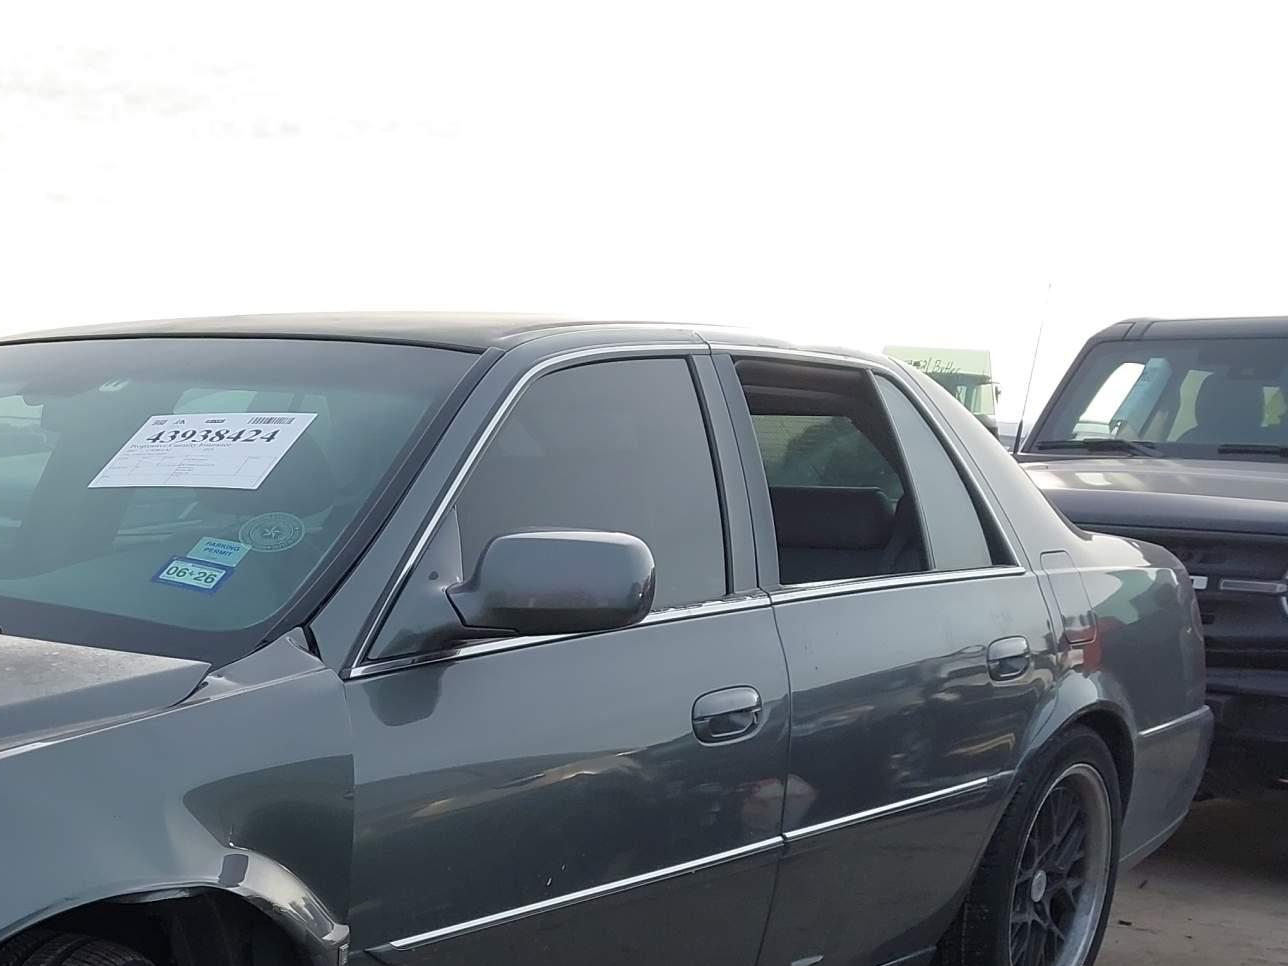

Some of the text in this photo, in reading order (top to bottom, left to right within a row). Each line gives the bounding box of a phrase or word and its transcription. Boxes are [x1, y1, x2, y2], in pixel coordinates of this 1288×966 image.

[145, 428, 281, 443] 43938424
[166, 566, 189, 578] 06
[193, 571, 217, 584] 26
